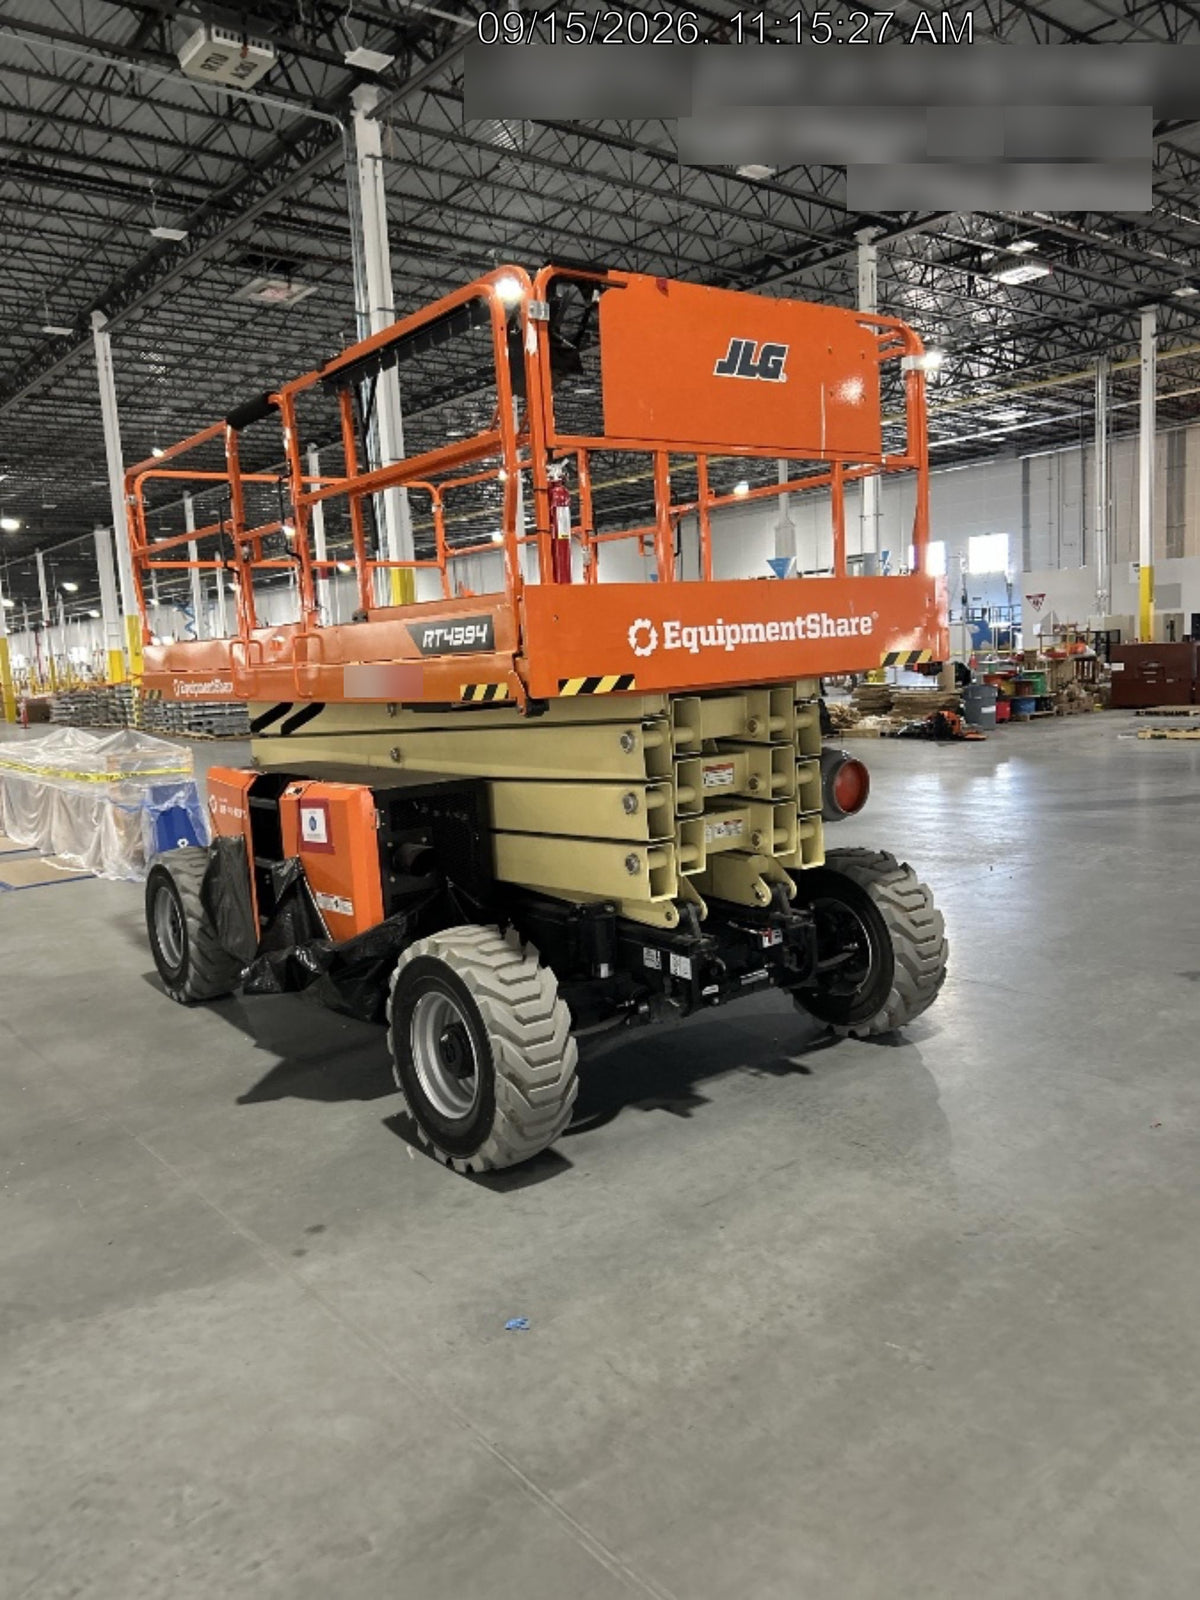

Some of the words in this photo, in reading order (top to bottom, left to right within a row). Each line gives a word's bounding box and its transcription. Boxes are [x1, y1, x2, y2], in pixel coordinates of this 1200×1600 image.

[713, 337, 789, 382] JLG
[422, 623, 488, 648] RT4394
[662, 612, 874, 654] EquipmentShare
